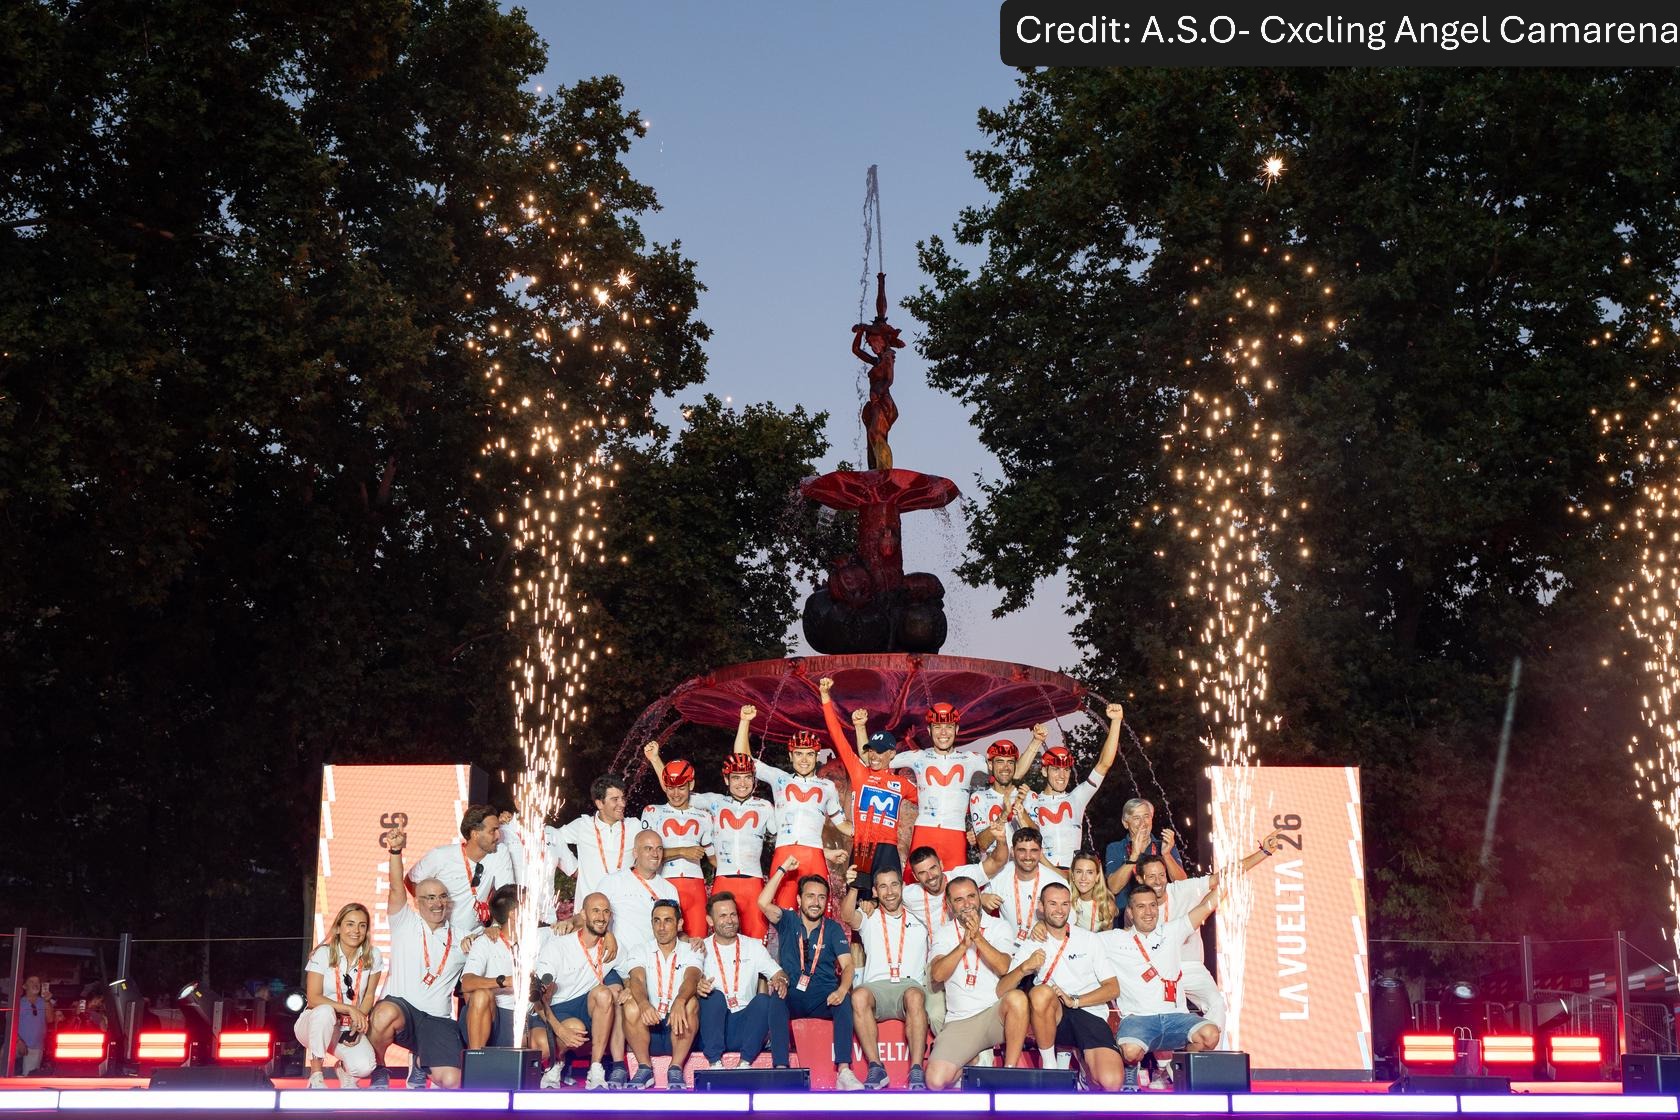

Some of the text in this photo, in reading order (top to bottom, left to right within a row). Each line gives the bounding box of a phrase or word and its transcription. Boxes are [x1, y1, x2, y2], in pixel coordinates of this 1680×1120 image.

[1272, 813, 1309, 1021] LA VUELTA 26
[853, 1042, 910, 1062] VELT
